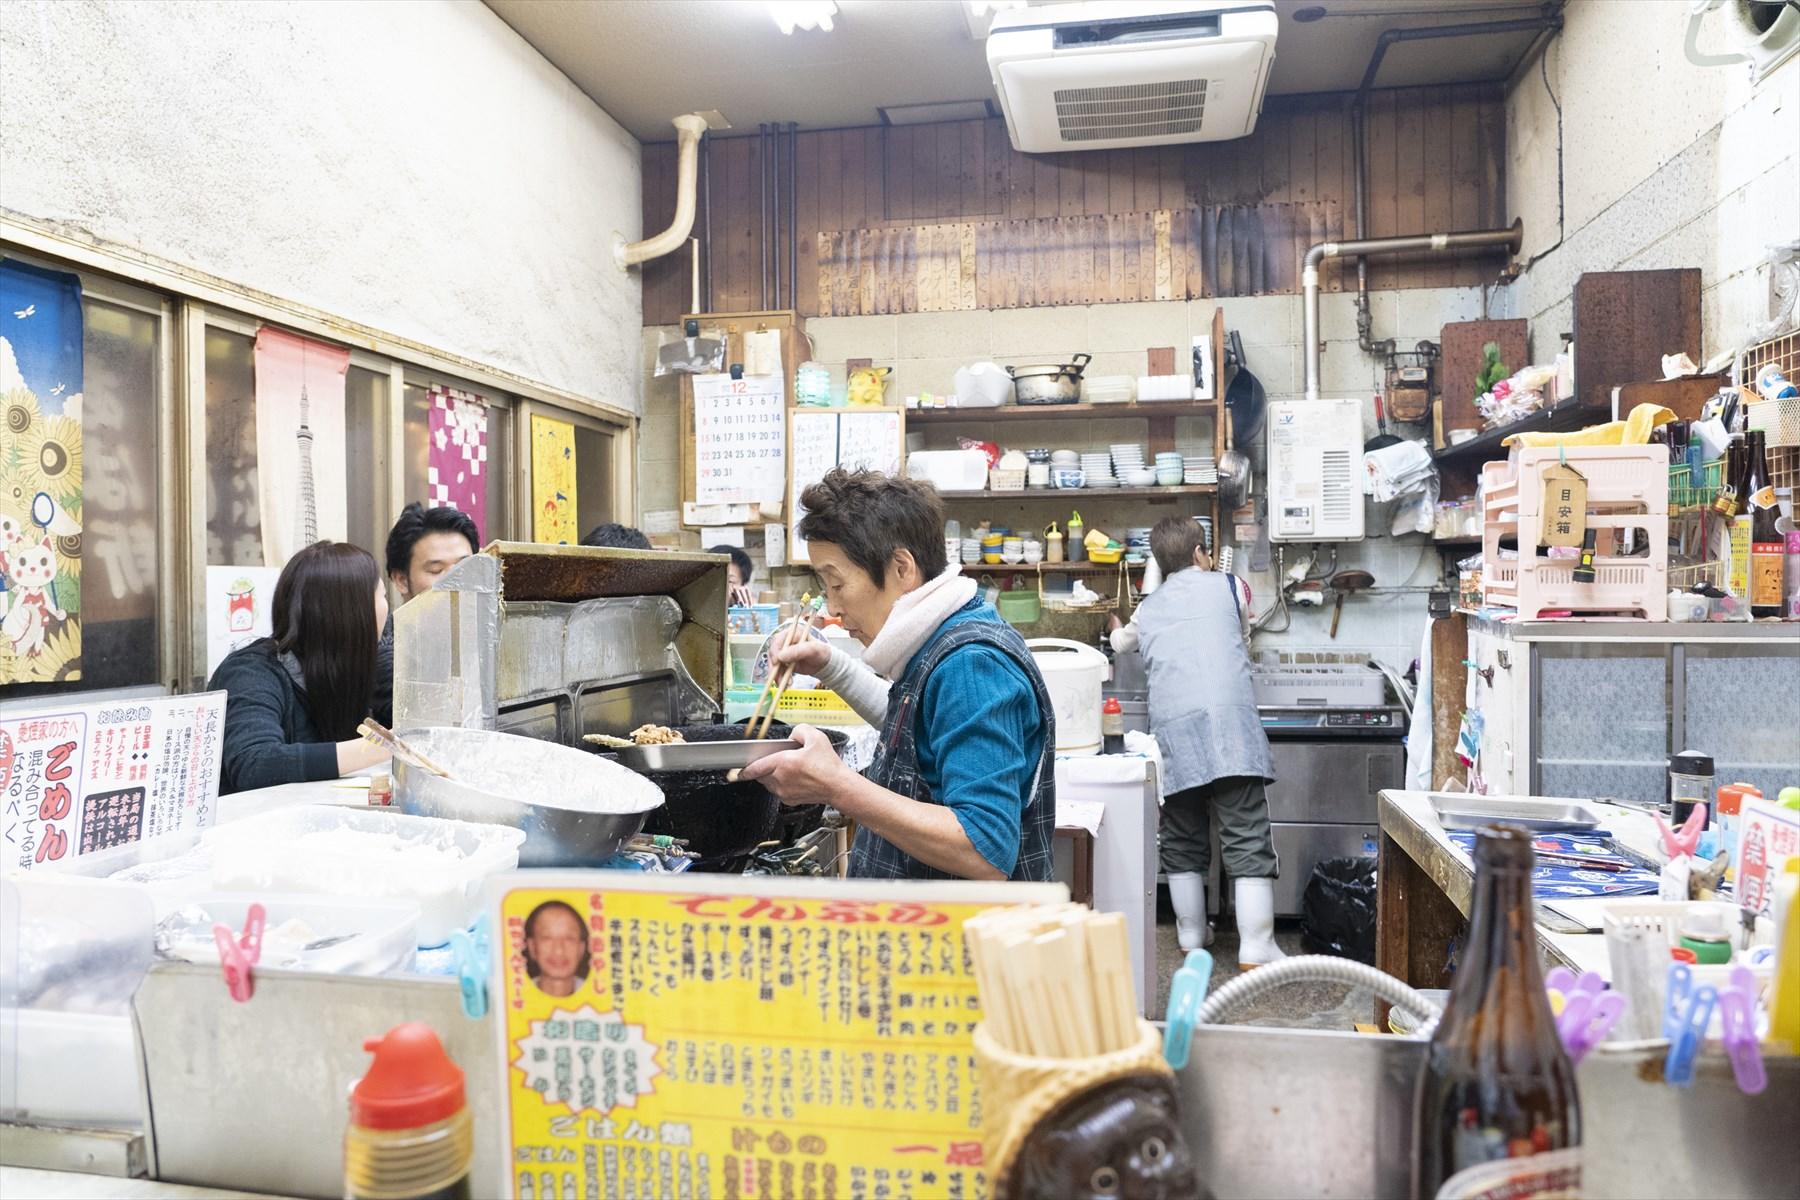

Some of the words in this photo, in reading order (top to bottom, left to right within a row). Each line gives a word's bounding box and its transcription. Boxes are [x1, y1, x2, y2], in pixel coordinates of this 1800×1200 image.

[731, 382, 747, 394] 12
[1556, 488, 1572, 535] 目安箱
[132, 726, 141, 750] ビール
[196, 708, 219, 828] 天長からのおすすめと
[5, 751, 25, 844] なるべく
[19, 750, 43, 870] 混み合ってる時
[648, 920, 661, 997] こんにゃく
[665, 922, 677, 988] ししゃも
[719, 924, 732, 979] サーモン
[940, 932, 955, 975] くじら
[840, 1051, 853, 1107] しいたけ
[550, 1115, 691, 1146] ごはん類
